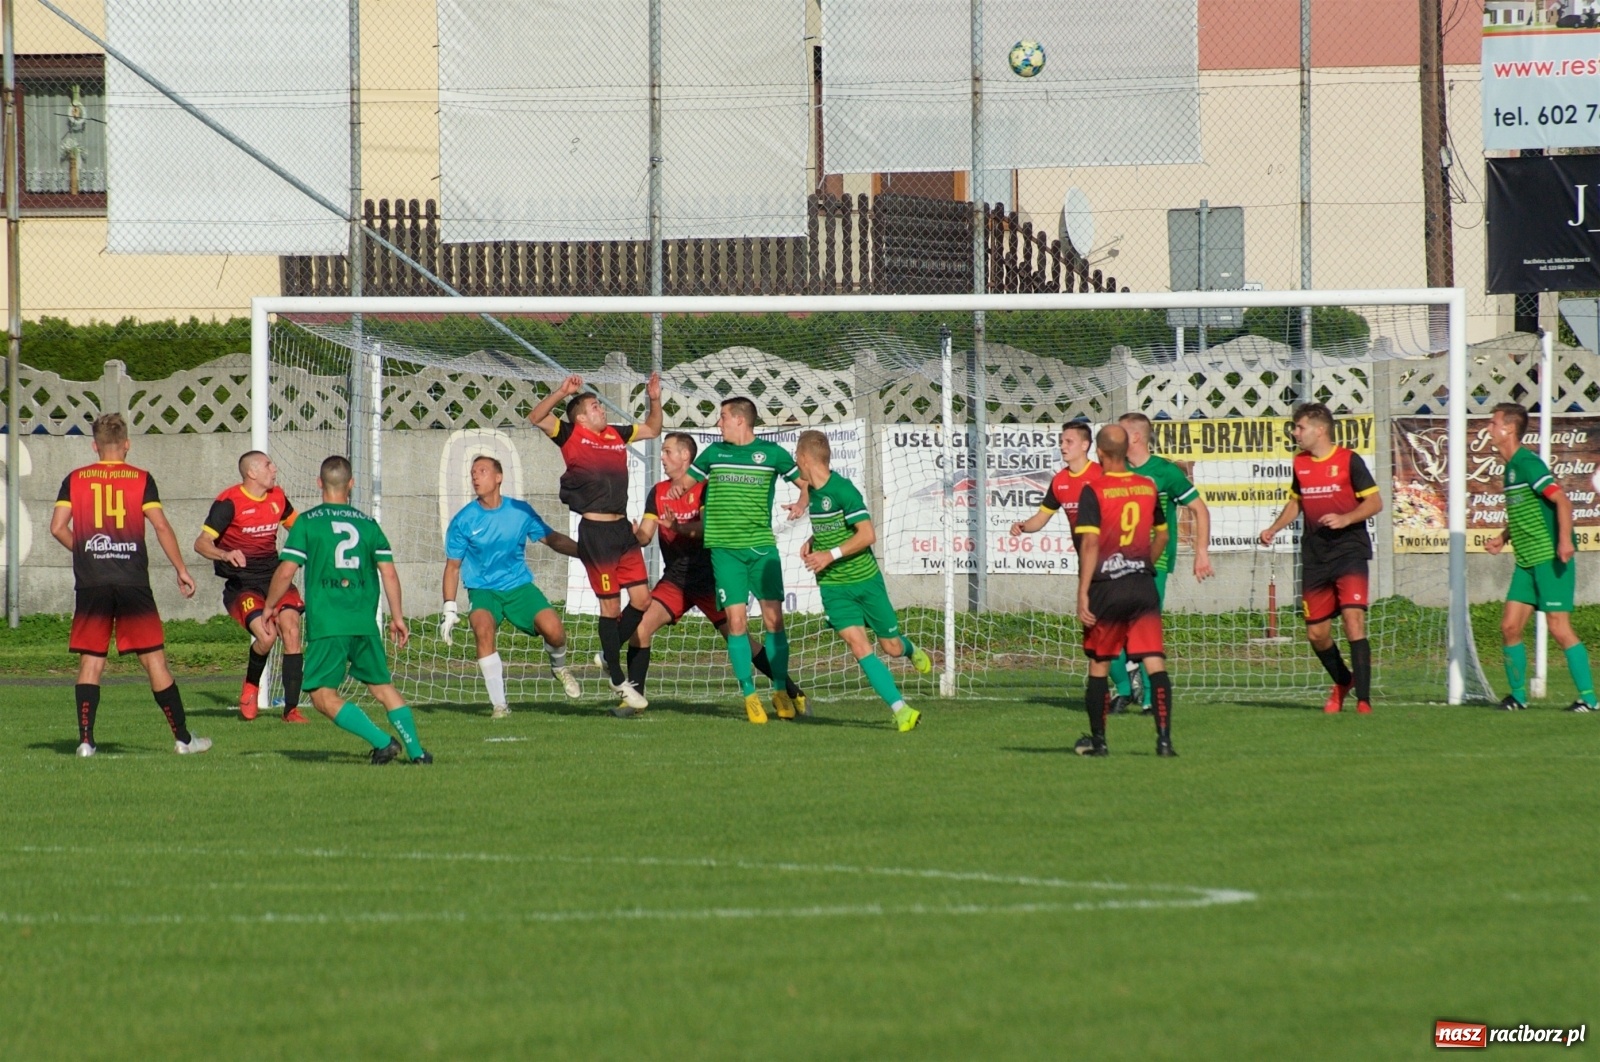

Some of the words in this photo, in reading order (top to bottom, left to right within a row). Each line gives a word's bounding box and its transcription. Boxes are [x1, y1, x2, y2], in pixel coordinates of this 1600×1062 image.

[1494, 106, 1529, 127] tel.
[1537, 104, 1577, 126] 602
[1586, 104, 1600, 123] 7
[1253, 464, 1293, 478] Produ
[90, 482, 127, 529] 14
[1473, 492, 1506, 506] pizze
[307, 509, 324, 519] LKS
[1120, 501, 1141, 547] 9
[85, 537, 137, 552] Alabama
[331, 521, 360, 569] 2
[912, 536, 943, 552] tel.
[997, 537, 1034, 552] 196
[994, 557, 1011, 569] ul.
[1016, 557, 1055, 569] Nowa
[1060, 557, 1069, 569] 8
[601, 573, 611, 592] 6
[718, 588, 727, 603] 3
